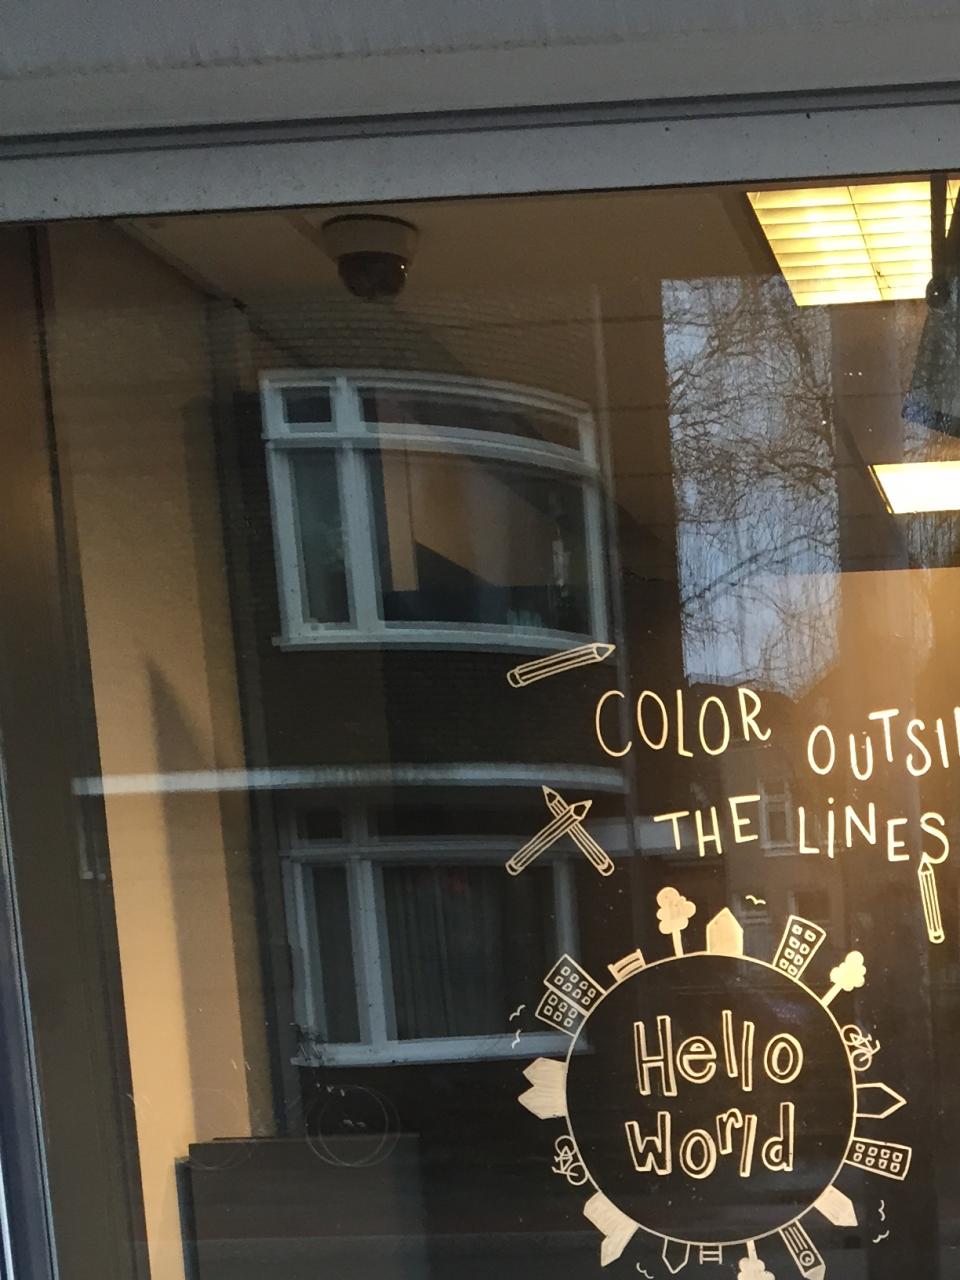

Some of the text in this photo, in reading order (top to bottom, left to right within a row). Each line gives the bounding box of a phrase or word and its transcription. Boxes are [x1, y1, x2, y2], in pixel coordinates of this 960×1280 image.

[596, 687, 772, 758] COLOR
[654, 794, 761, 857] THE
[633, 1010, 804, 1097] Hello
